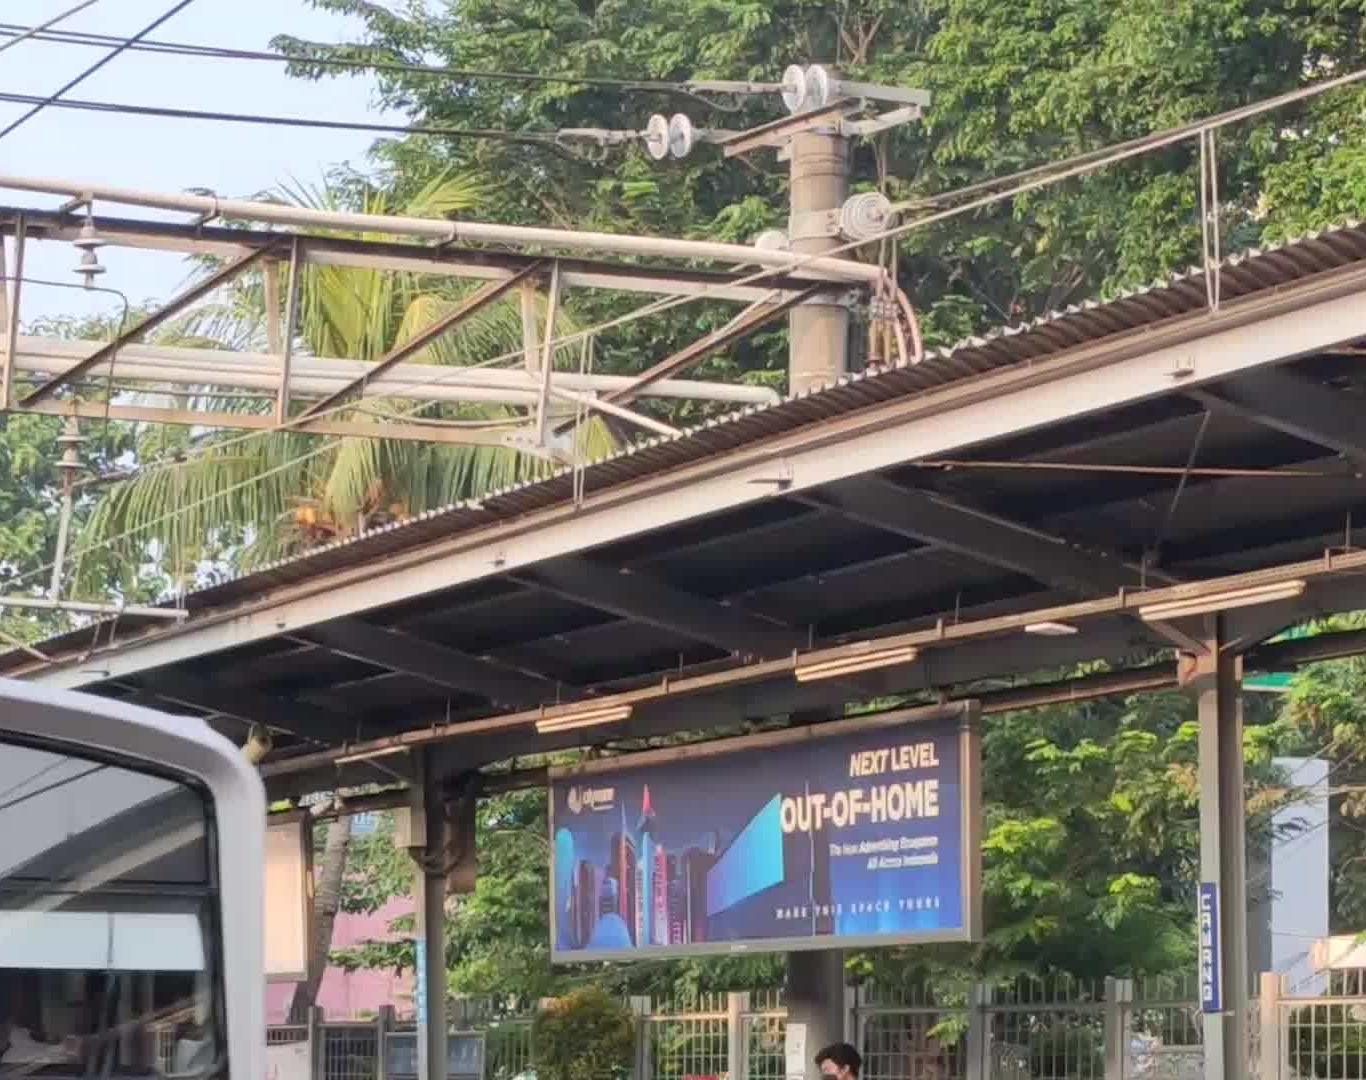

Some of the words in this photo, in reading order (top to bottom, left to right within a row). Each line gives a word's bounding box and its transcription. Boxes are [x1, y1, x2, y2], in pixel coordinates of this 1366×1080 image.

[849, 748, 891, 778] NEXT
[891, 742, 939, 771] LEVEL
[779, 779, 939, 834] OUT-OF-HOME
